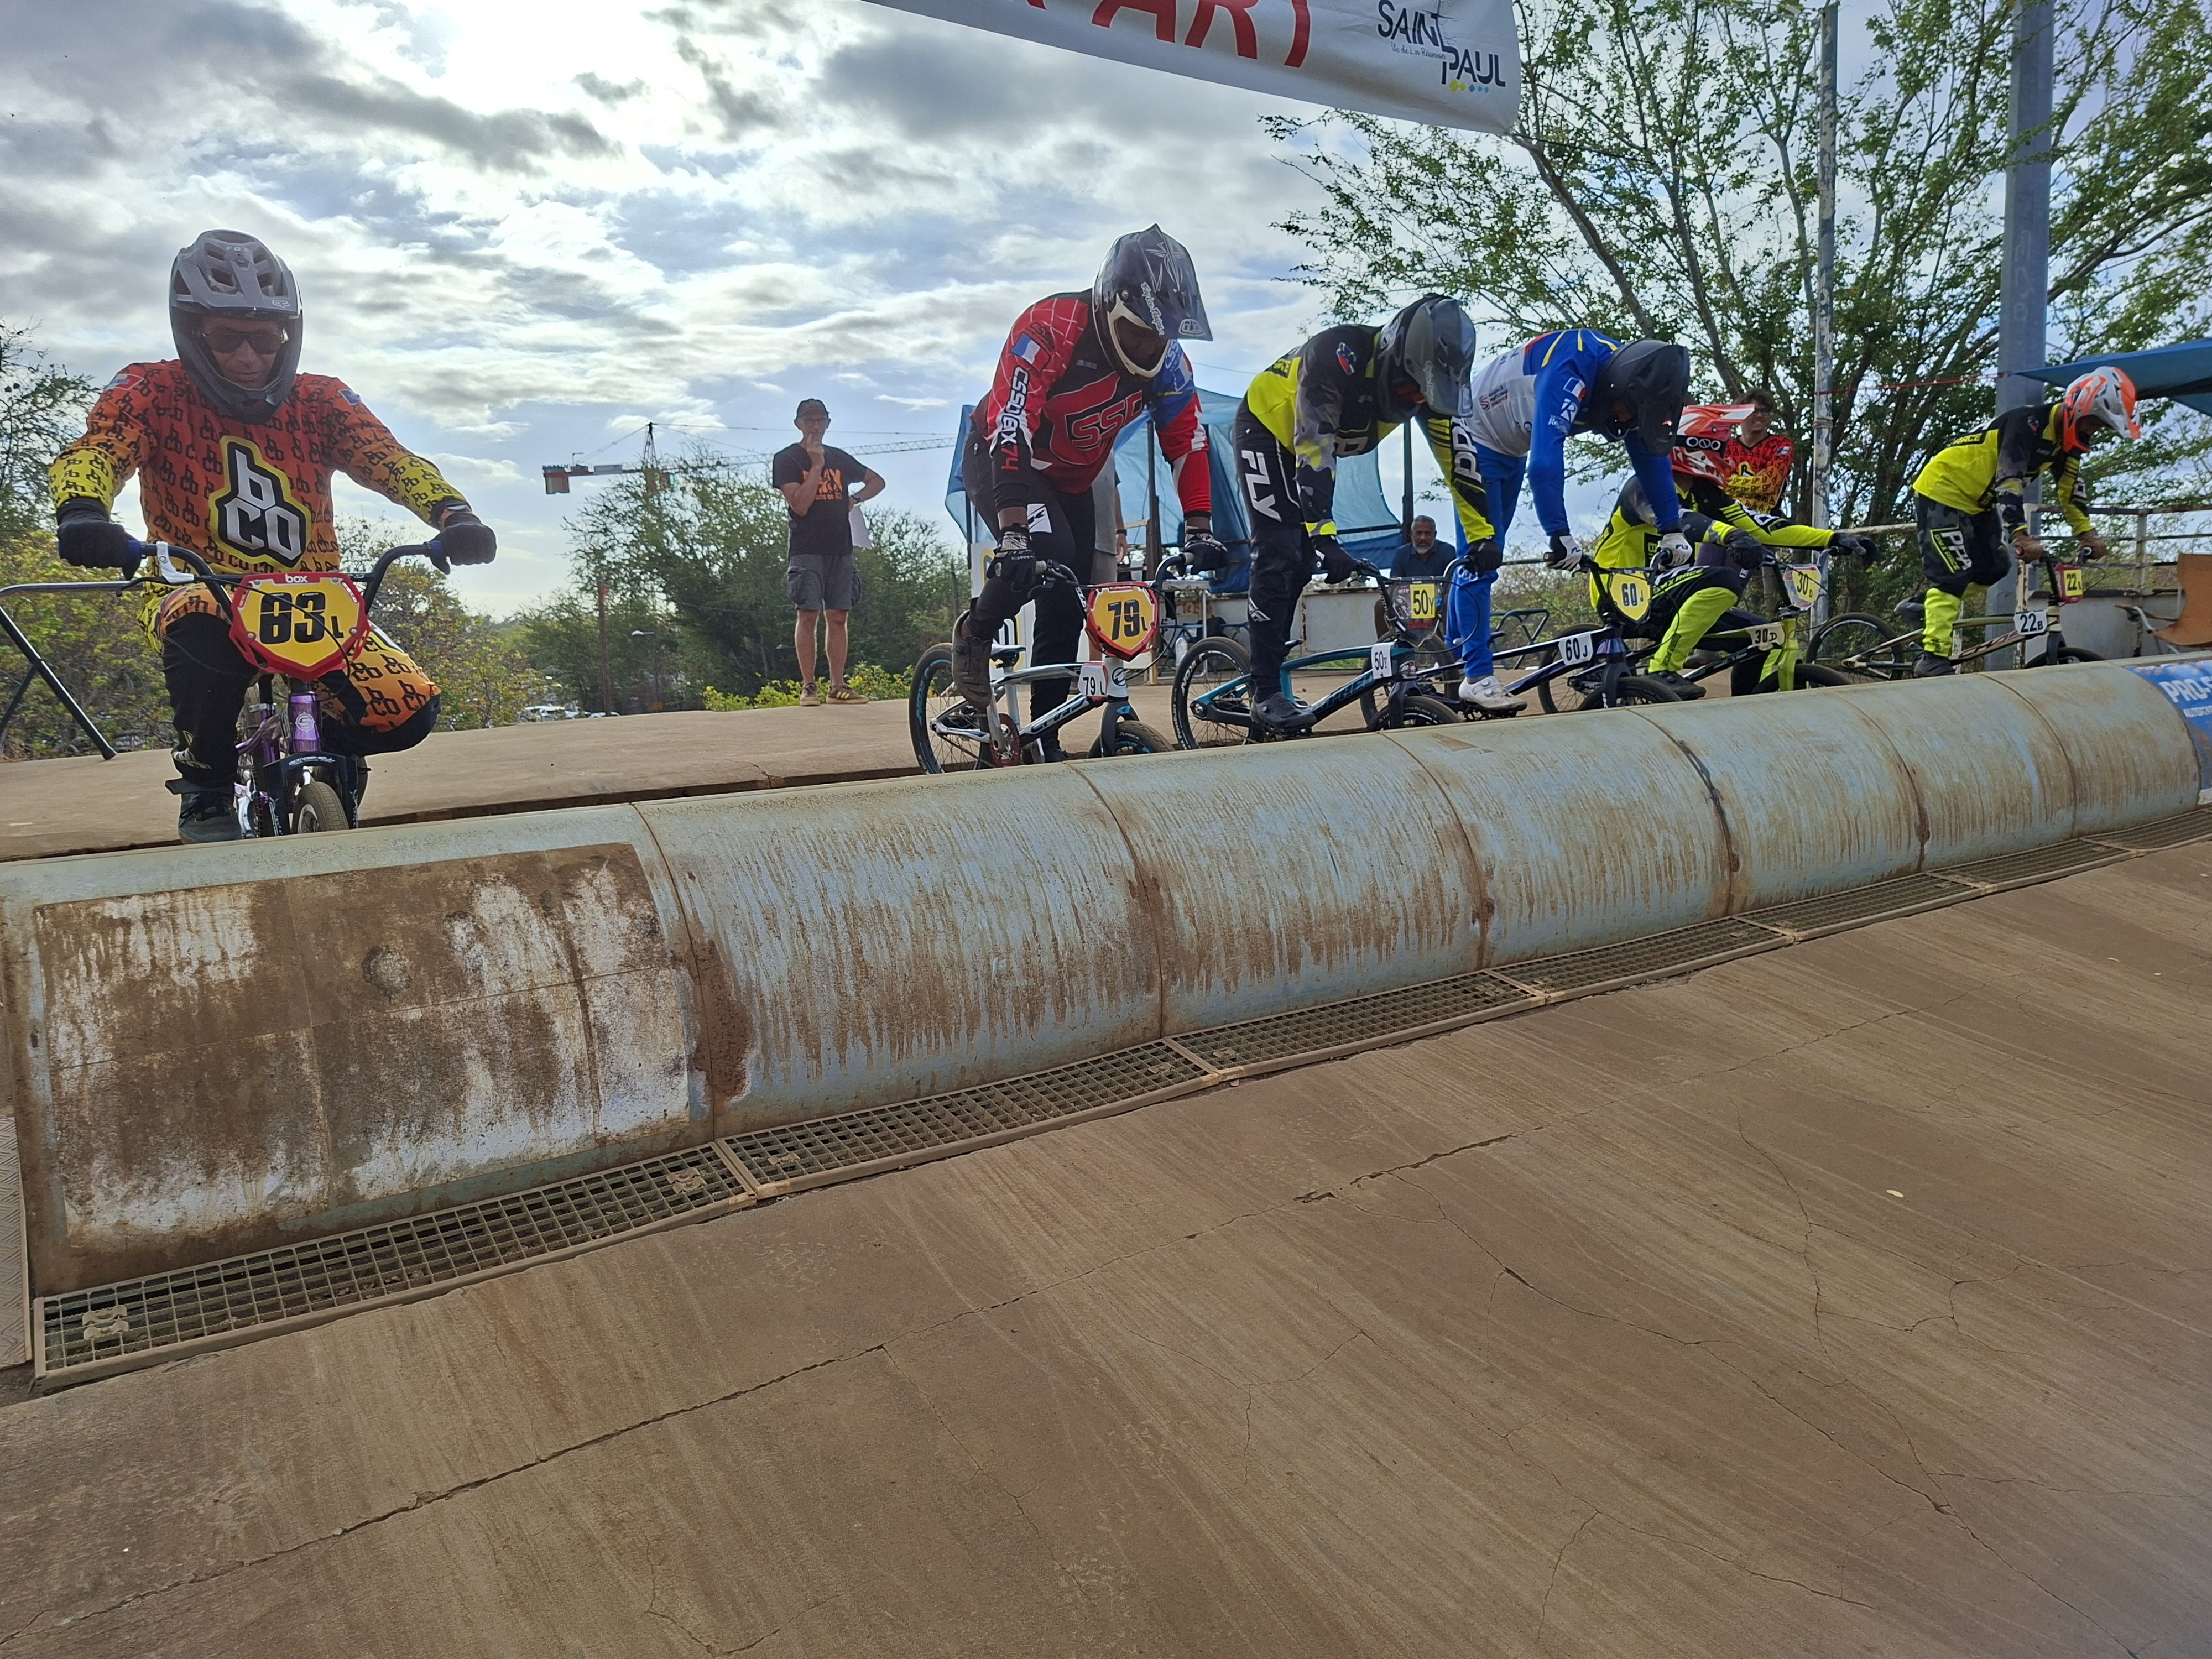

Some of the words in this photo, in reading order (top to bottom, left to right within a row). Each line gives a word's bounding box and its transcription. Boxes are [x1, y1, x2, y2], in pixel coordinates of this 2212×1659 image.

[1441, 46, 1506, 87] PAUL
[1241, 450, 1282, 522] FLY
[285, 573, 308, 583] box
